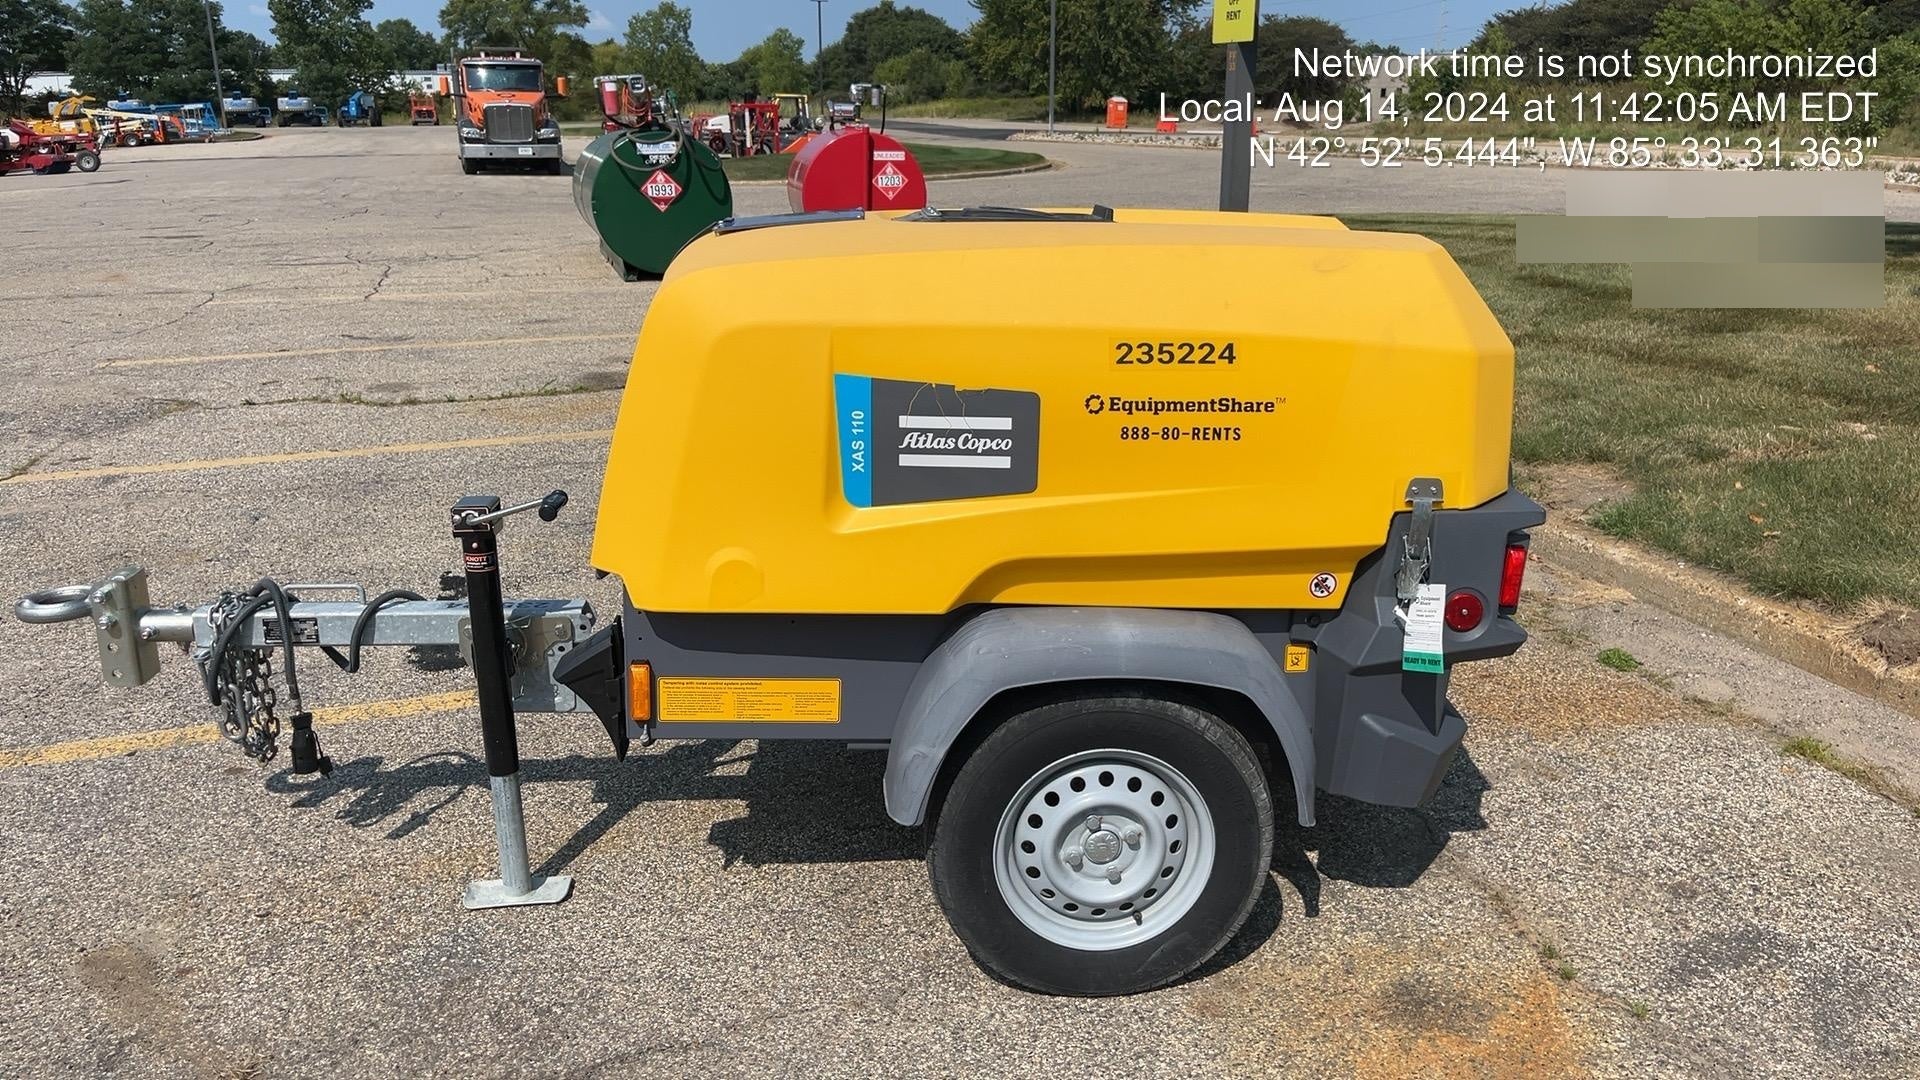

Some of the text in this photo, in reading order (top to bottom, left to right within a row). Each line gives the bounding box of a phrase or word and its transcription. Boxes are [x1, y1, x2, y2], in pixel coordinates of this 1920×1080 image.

[1226, 10, 1241, 21] RENT
[880, 175, 901, 187] 1203
[650, 184, 674, 196] 1993
[1115, 342, 1237, 365] 235224
[1120, 426, 1242, 441] 888-80-RENTS
[851, 410, 865, 472] XAS 110
[898, 431, 1013, 454] Atlas Copco
[1404, 656, 1441, 667] READY TO RENT
